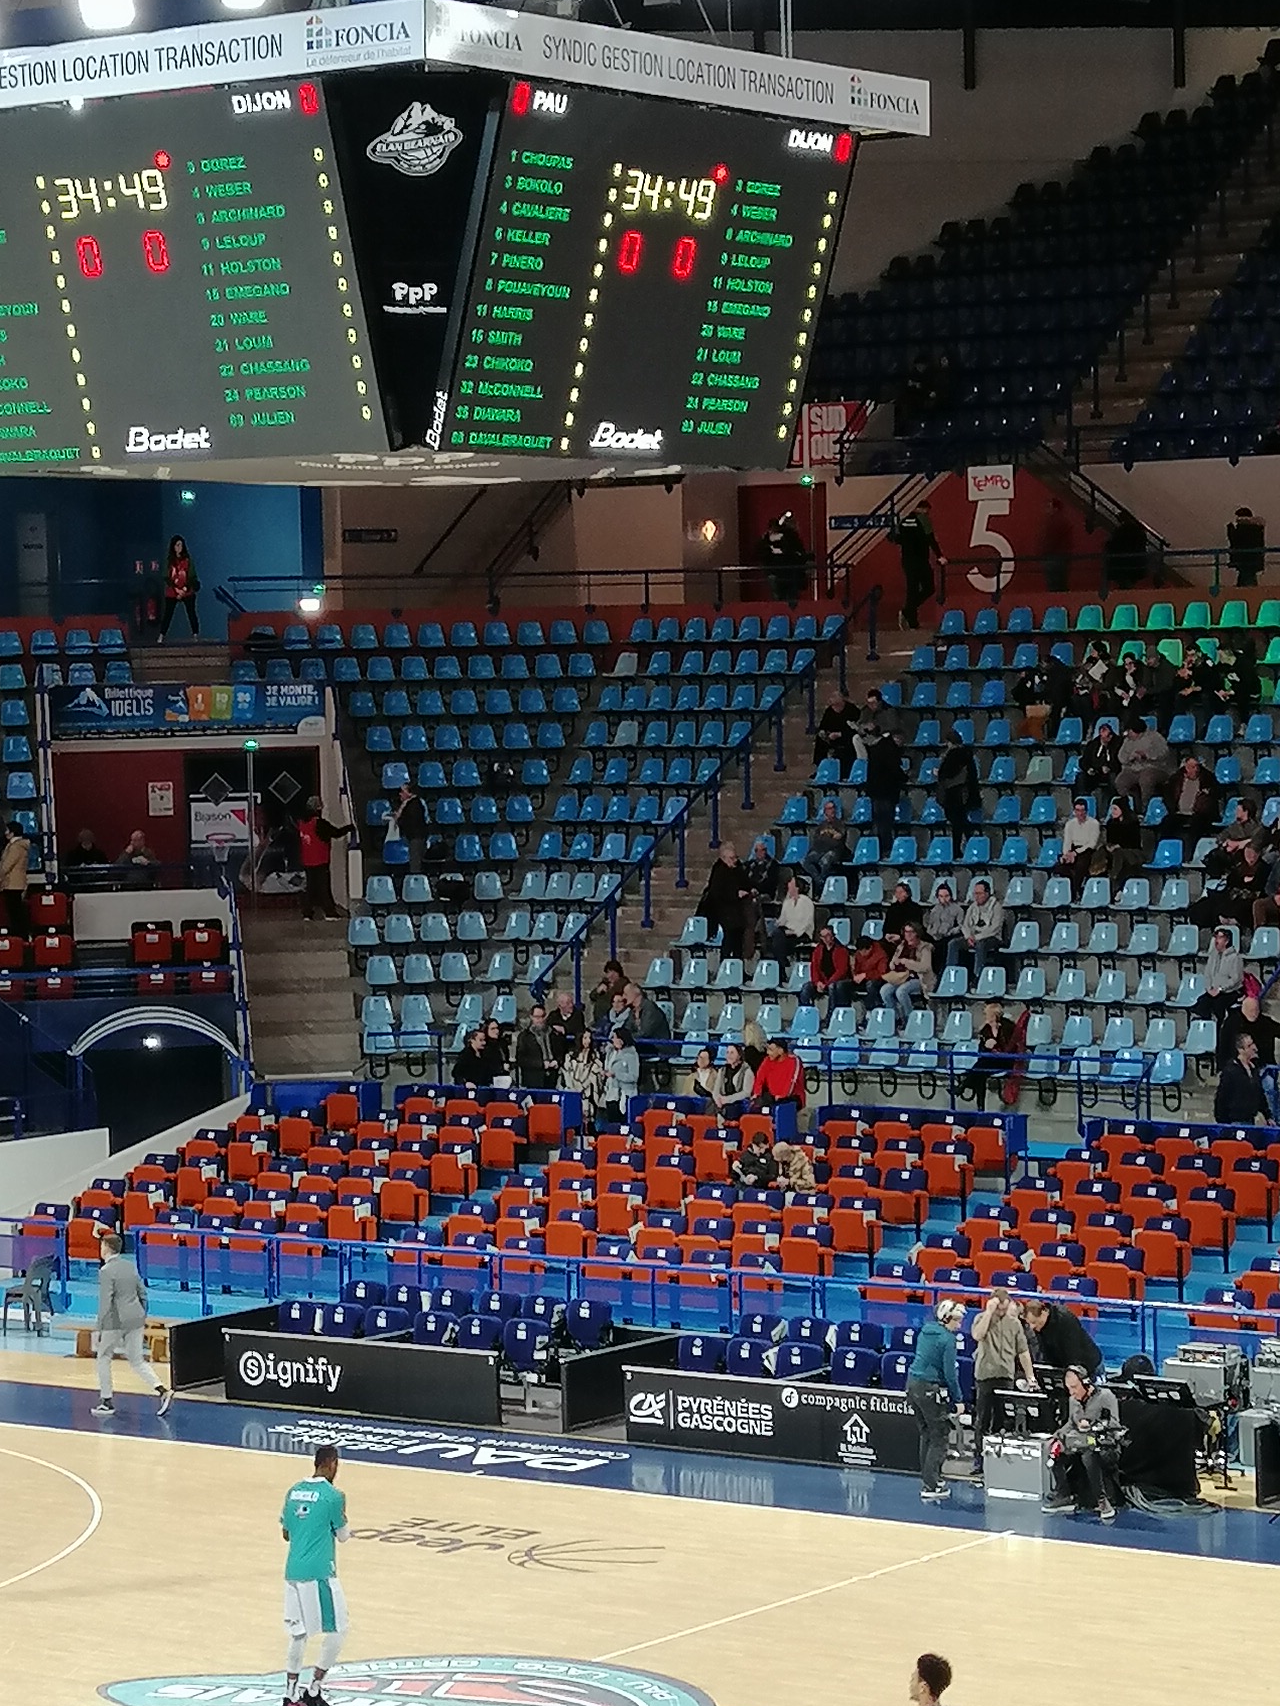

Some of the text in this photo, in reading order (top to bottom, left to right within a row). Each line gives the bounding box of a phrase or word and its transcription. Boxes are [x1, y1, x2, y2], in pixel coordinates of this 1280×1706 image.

[335, 22, 410, 47] FONCIA
[460, 29, 523, 51] FONCIA
[63, 50, 149, 81] LOCATION
[155, 34, 282, 70] TRANSACTION
[543, 34, 597, 67] SYNDIC
[602, 45, 664, 78] GESTION
[668, 57, 737, 91] LOCATION
[740, 68, 835, 105] TRANSACTION
[231, 89, 291, 114] DIJON
[532, 90, 568, 114] PAU
[870, 92, 920, 116] FONCIA
[787, 129, 834, 153] DIJON
[54, 169, 168, 219] 34:49
[205, 181, 252, 198] WEBER
[621, 170, 716, 220] 34:49
[77, 236, 103, 277] 0
[144, 230, 170, 272] 0
[619, 230, 642, 273] 0
[673, 237, 697, 278] 0
[220, 257, 282, 275] HOLSTON
[245, 385, 306, 401] PEARSON
[426, 391, 448, 451] Bodet
[810, 406, 848, 432] SUD
[126, 425, 212, 453] Bodet
[588, 421, 664, 451] Bodet
[971, 474, 1011, 492] TEMPO
[967, 499, 1015, 593] 5
[677, 1394, 773, 1420] PYRÉNÉES
[800, 1392, 867, 1412] compagnie
[677, 1412, 774, 1436] GASCOGNE
